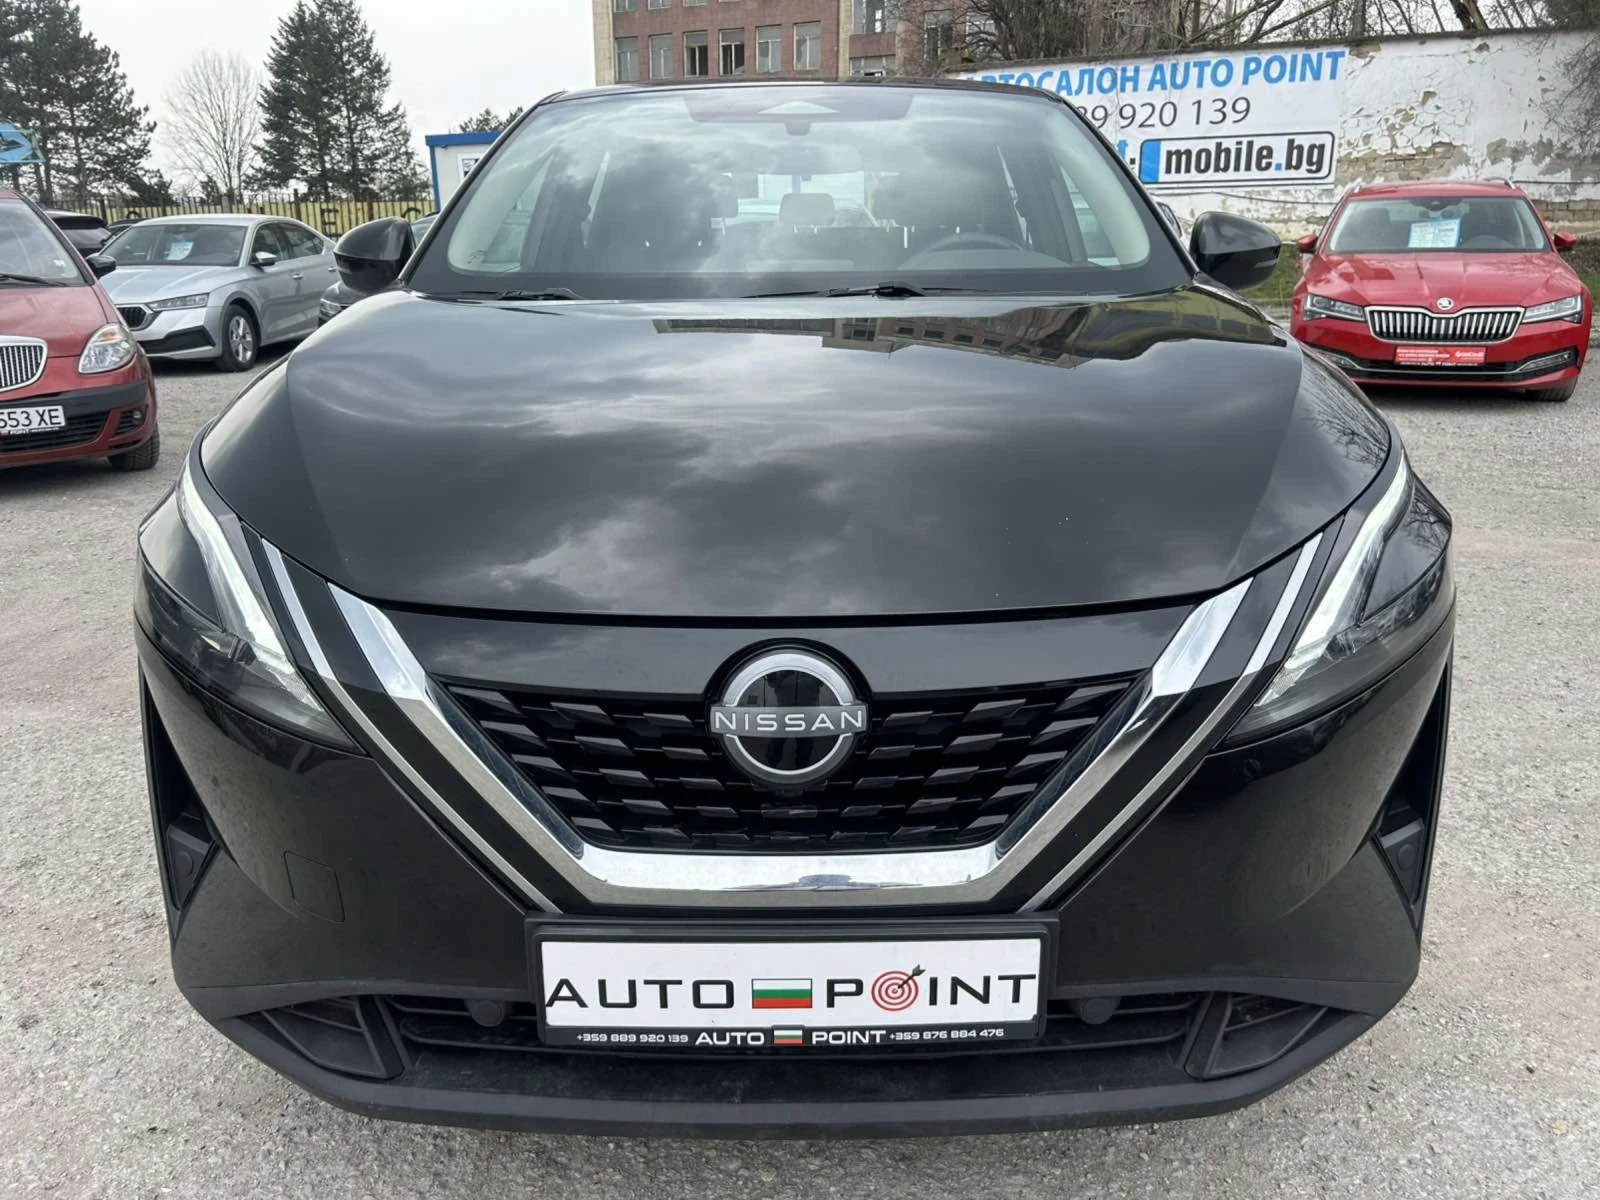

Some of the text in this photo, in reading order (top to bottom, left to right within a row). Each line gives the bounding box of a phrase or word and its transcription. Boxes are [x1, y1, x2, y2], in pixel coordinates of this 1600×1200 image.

[1147, 58, 1234, 91] AUTO
[1242, 51, 1346, 86] POINT
[1119, 101, 1178, 129] 920
[1191, 97, 1252, 125] 139
[1164, 138, 1326, 175] mobile.bg
[35, 408, 61, 427] XE
[715, 710, 862, 731] NISSAN
[545, 978, 734, 1009] AUTO
[576, 1028, 1004, 1045] +359 889 920 139 AUTO POINT +359 876 884 476
